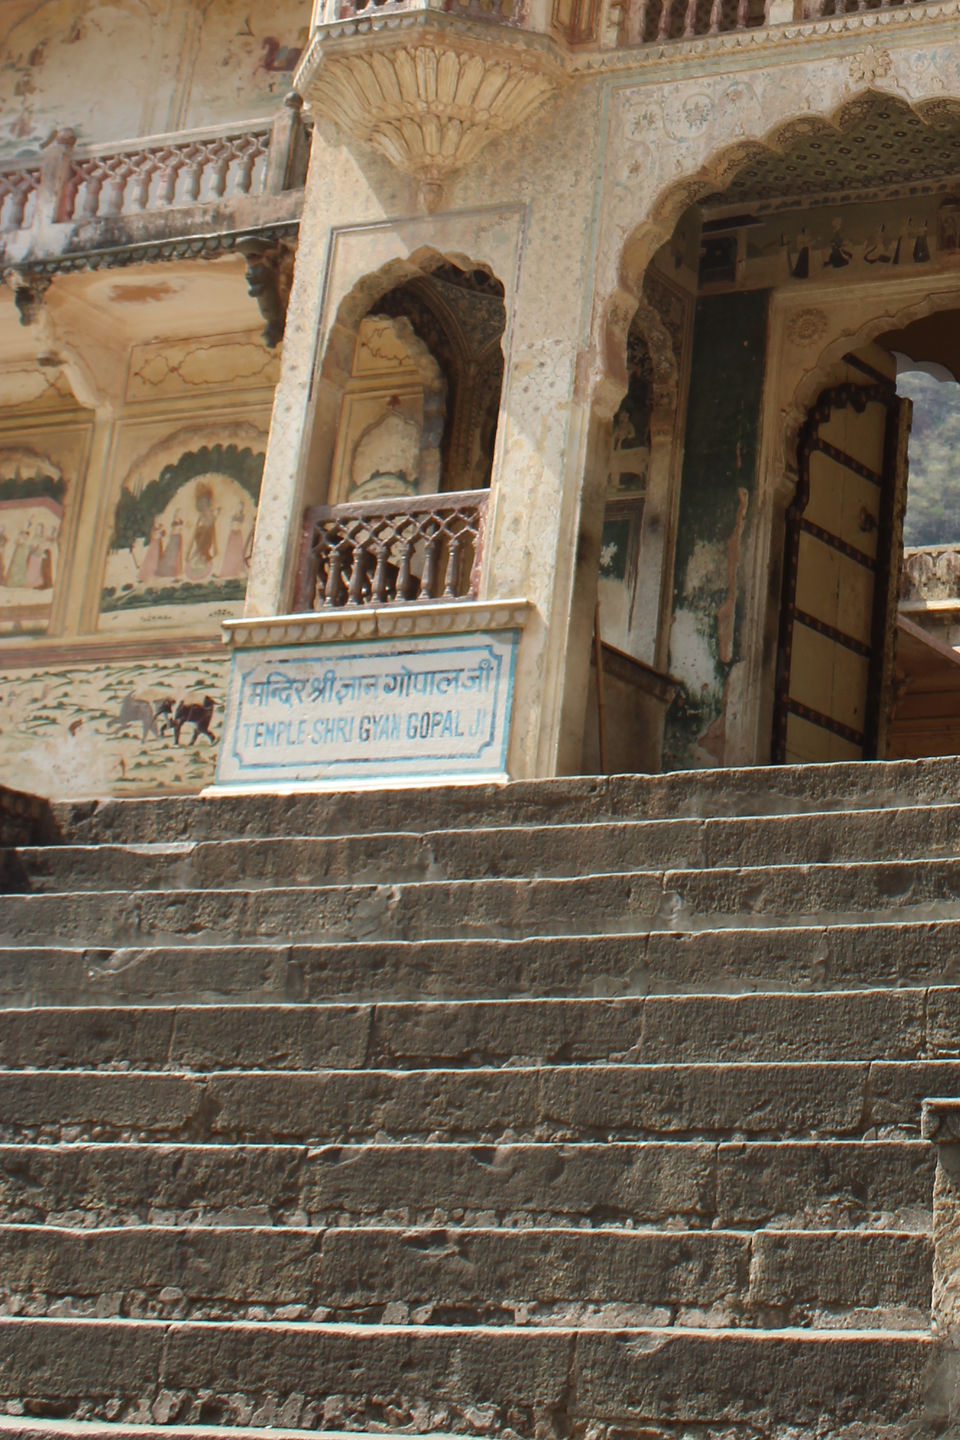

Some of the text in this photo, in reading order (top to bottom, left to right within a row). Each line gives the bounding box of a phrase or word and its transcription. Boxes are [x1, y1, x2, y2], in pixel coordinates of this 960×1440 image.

[247, 671, 309, 708] मन्दिर
[308, 669, 337, 703] श्री
[335, 674, 379, 705] ज्ञान
[383, 664, 465, 698] गोपाल
[242, 708, 487, 748] TEMPLE SHRI GYAN GOPAL JI
